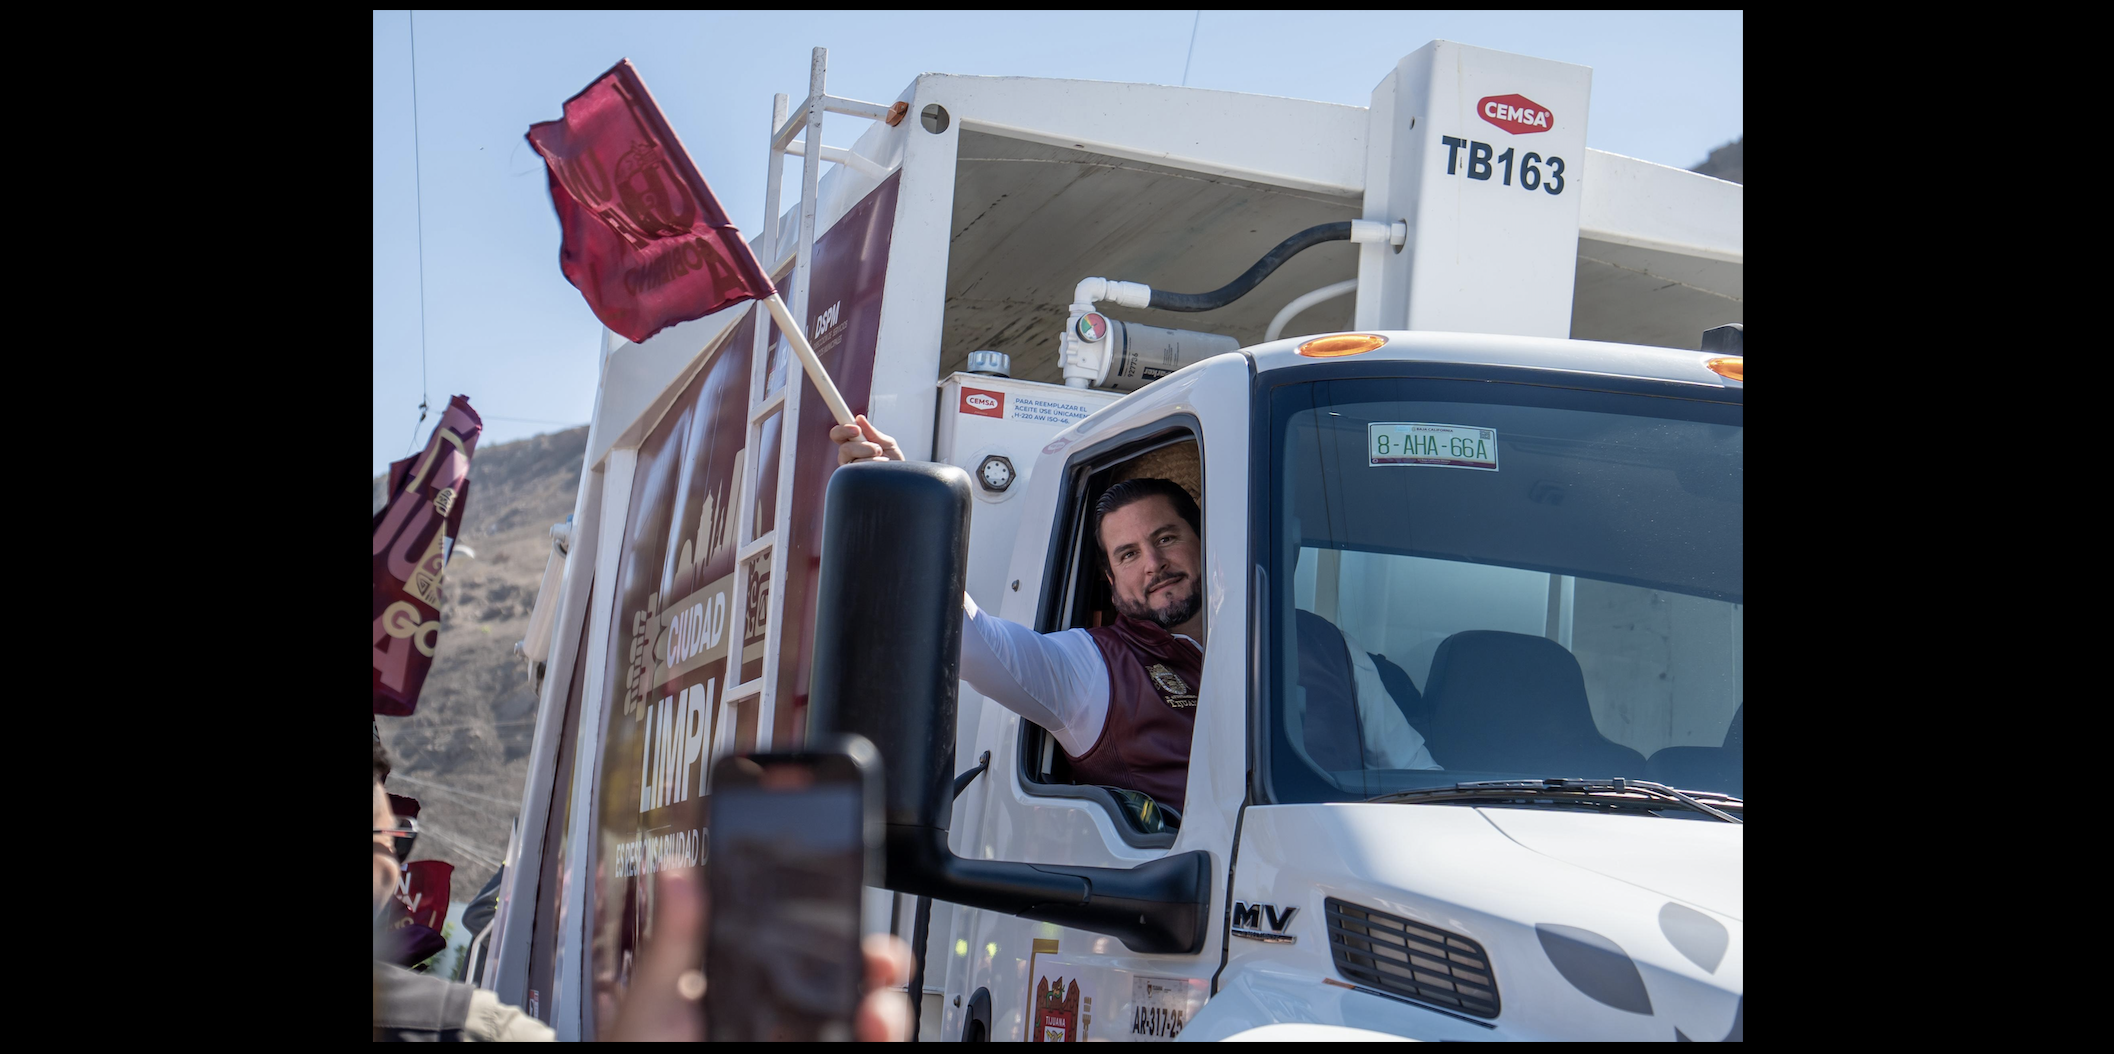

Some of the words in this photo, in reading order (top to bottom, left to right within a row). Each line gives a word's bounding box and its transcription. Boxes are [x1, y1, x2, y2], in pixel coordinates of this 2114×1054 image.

[1484, 101, 1548, 128] CEMSA
[1442, 135, 1565, 195] TB163
[815, 300, 841, 340] DSPM
[1128, 352, 1139, 378] 927736
[969, 397, 995, 407] CEMSA
[1014, 405, 1038, 413] ACEITE
[1015, 398, 1034, 406] PARA
[1034, 400, 1079, 411] REEMPLAZAR
[1377, 434, 1488, 459] 8-AHA-66A
[666, 591, 727, 669] CIUDAD
[625, 828, 700, 878] RESPONSABILIDAD
[1232, 900, 1300, 934] MV
[1045, 1015, 1066, 1028] TIJUANA
[1132, 1005, 1184, 1038] AR-317-25
